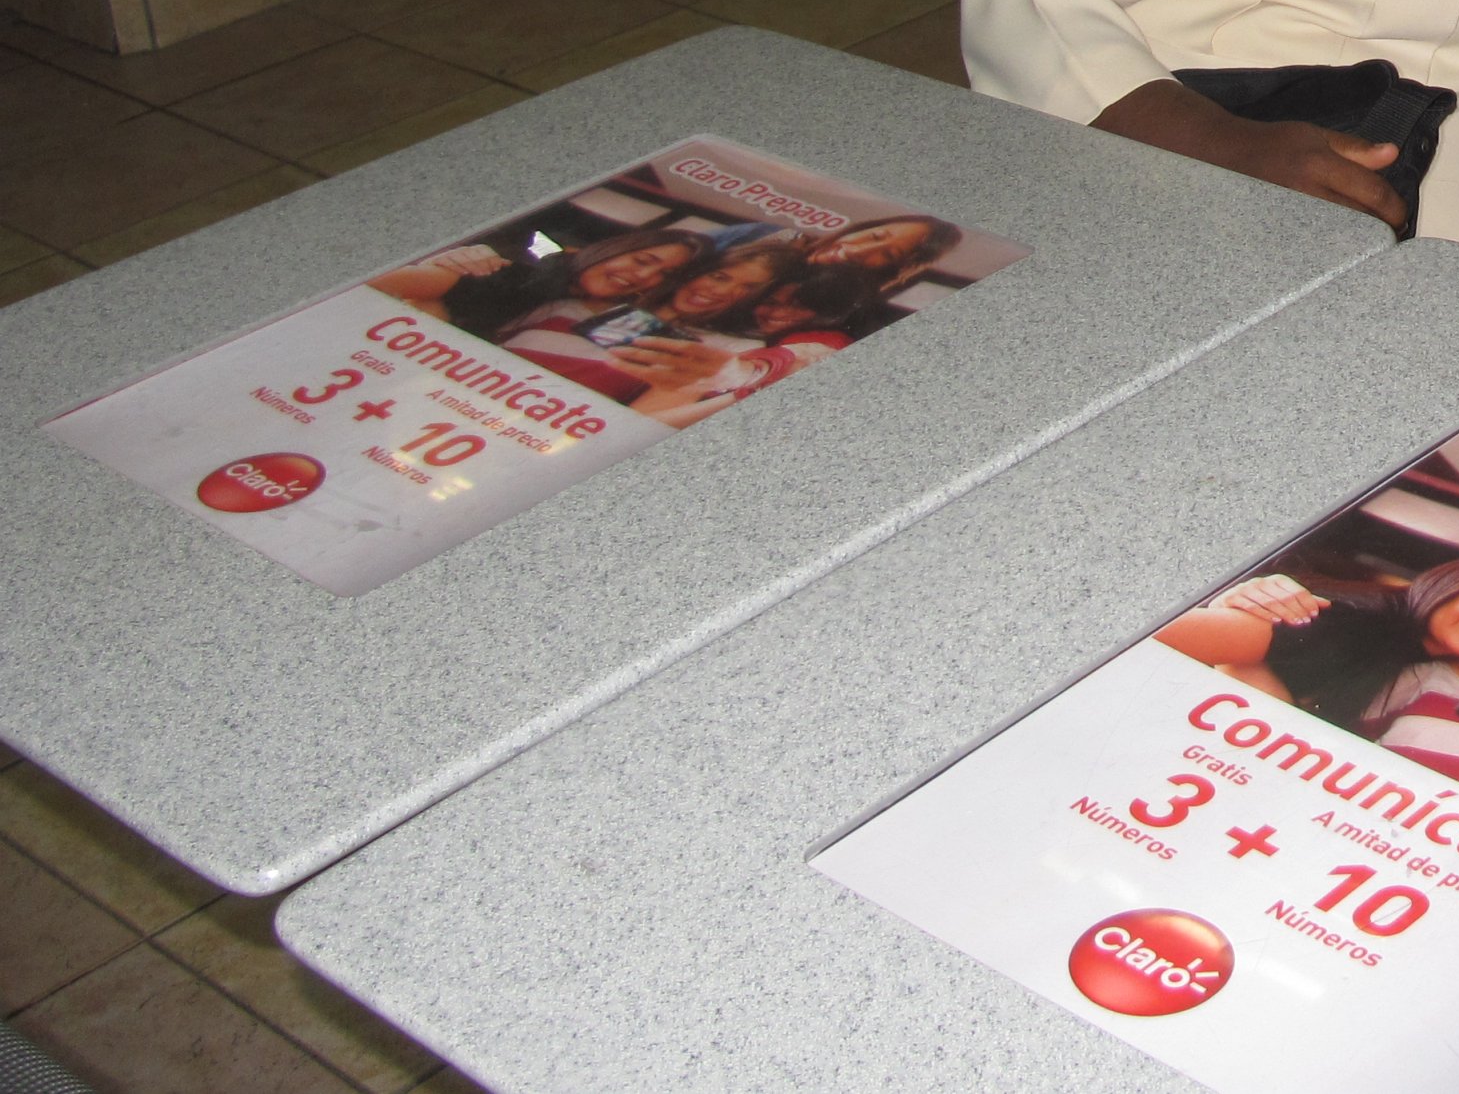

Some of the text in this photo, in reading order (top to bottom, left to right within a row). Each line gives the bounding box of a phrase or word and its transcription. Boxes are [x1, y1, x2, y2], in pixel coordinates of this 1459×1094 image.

[674, 159, 846, 229] Claro Prepago
[350, 349, 397, 376] Gratis
[366, 315, 607, 440] Comunícate
[250, 385, 317, 425] Números
[292, 368, 365, 405] 3
[398, 421, 487, 467] 10
[425, 389, 553, 452] A mitad de precio
[226, 462, 286, 499] Claro
[361, 445, 432, 485] Números
[1182, 744, 1253, 786] Gratis
[1070, 795, 1179, 861] Números
[1129, 773, 1215, 828] 3
[1313, 863, 1430, 938] 10
[1311, 810, 1336, 828] A
[1334, 821, 1411, 862] mitad
[1406, 856, 1441, 878] de
[1094, 926, 1191, 991] Claro
[1264, 899, 1384, 968] Números
